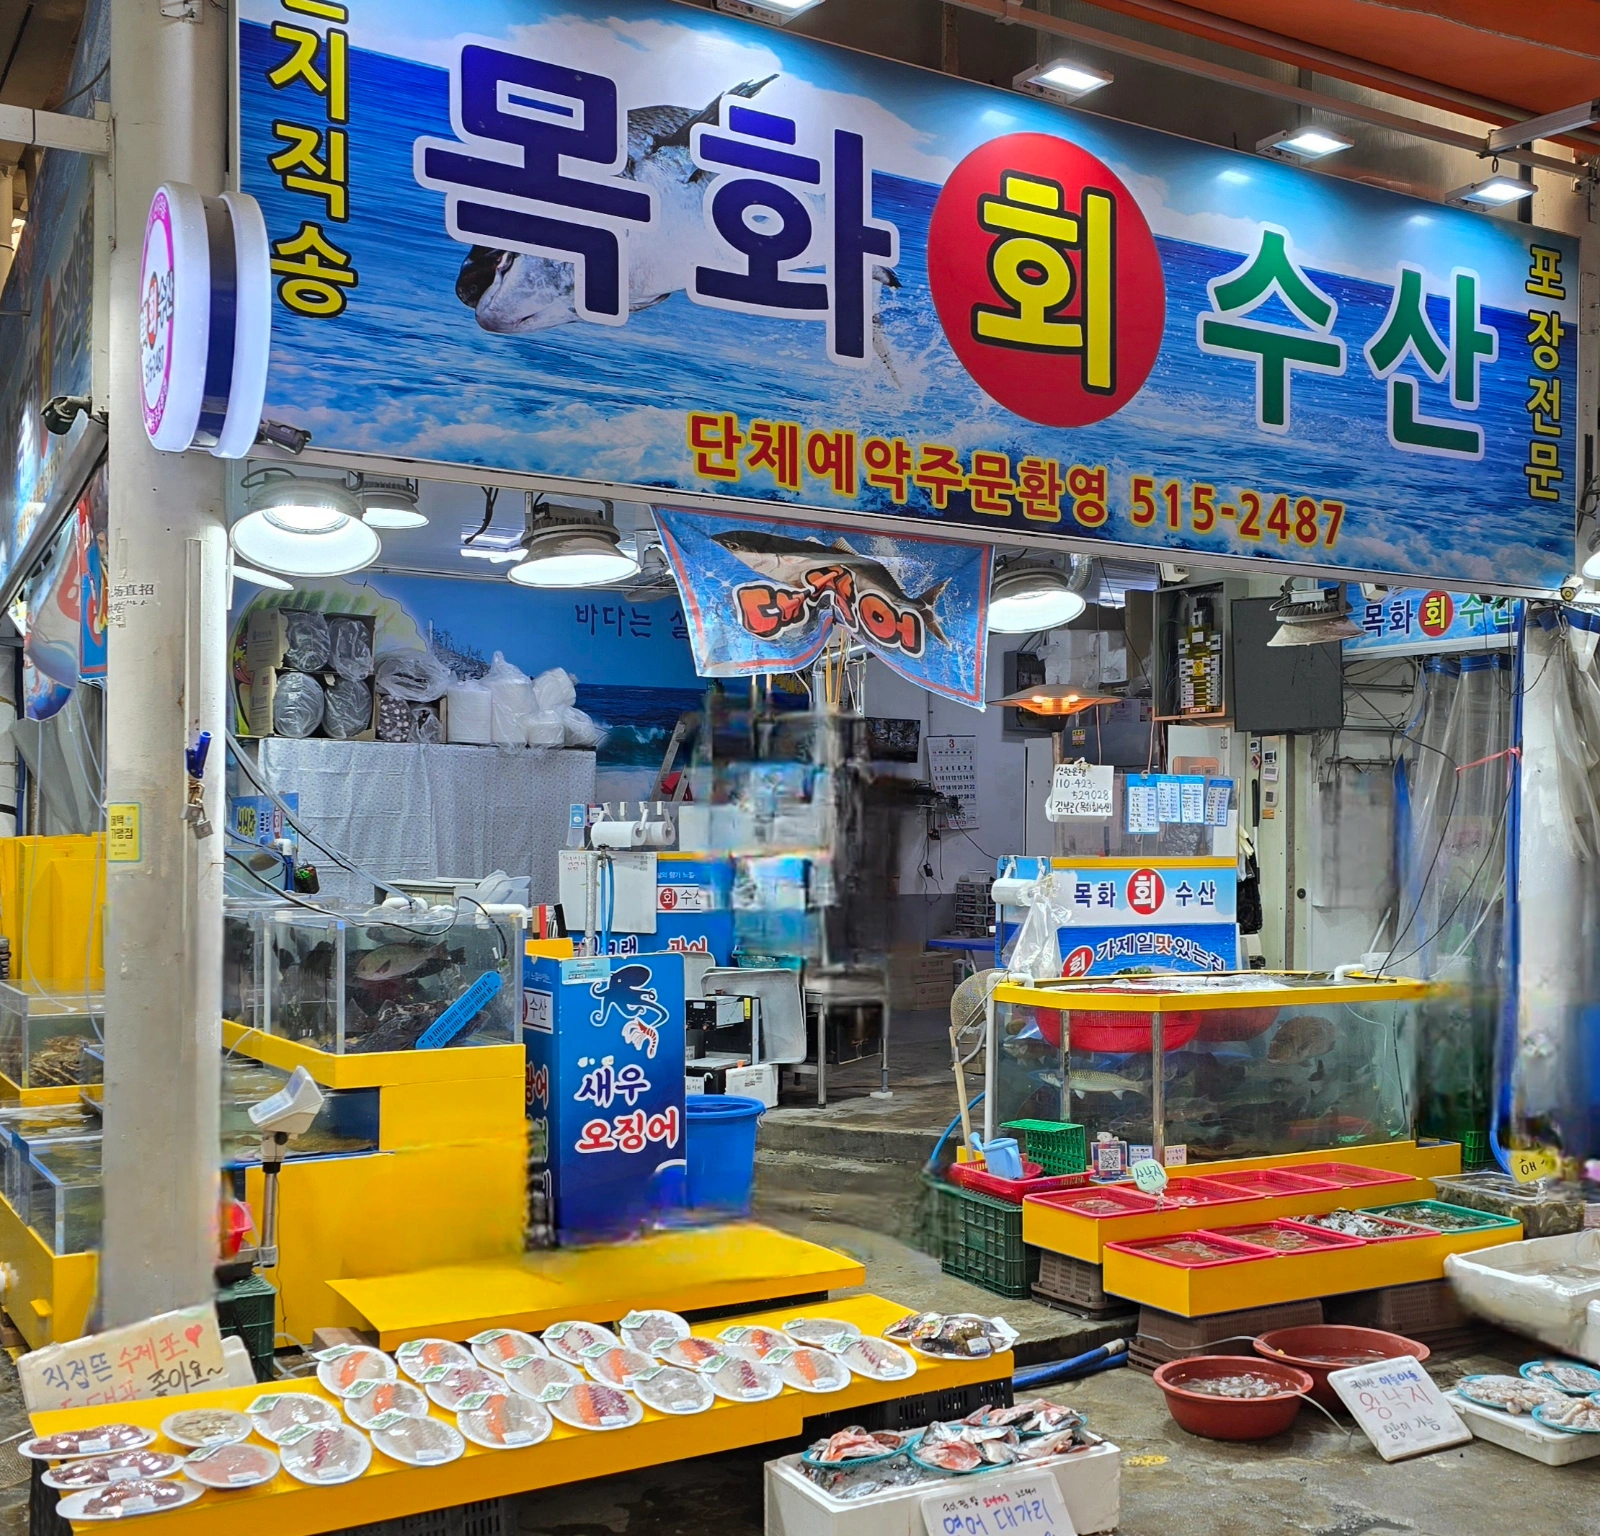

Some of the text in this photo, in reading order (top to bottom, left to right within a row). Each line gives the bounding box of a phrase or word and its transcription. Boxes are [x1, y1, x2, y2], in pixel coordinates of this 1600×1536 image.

[264, 0, 360, 319] 지직송
[418, 38, 1496, 457] 목화 회 수산
[1524, 244, 1566, 502] 포장전문
[688, 410, 1346, 549] 단체예약주문환영 515-2487
[574, 603, 653, 638] 바다는
[1362, 600, 1413, 637] 목화
[1423, 595, 1446, 629] 회
[1073, 875, 1216, 909] 목화 회 수산
[576, 1066, 649, 1106] 새우
[576, 1107, 679, 1152] 오징어
[993, 1498, 1054, 1531] 대가리
